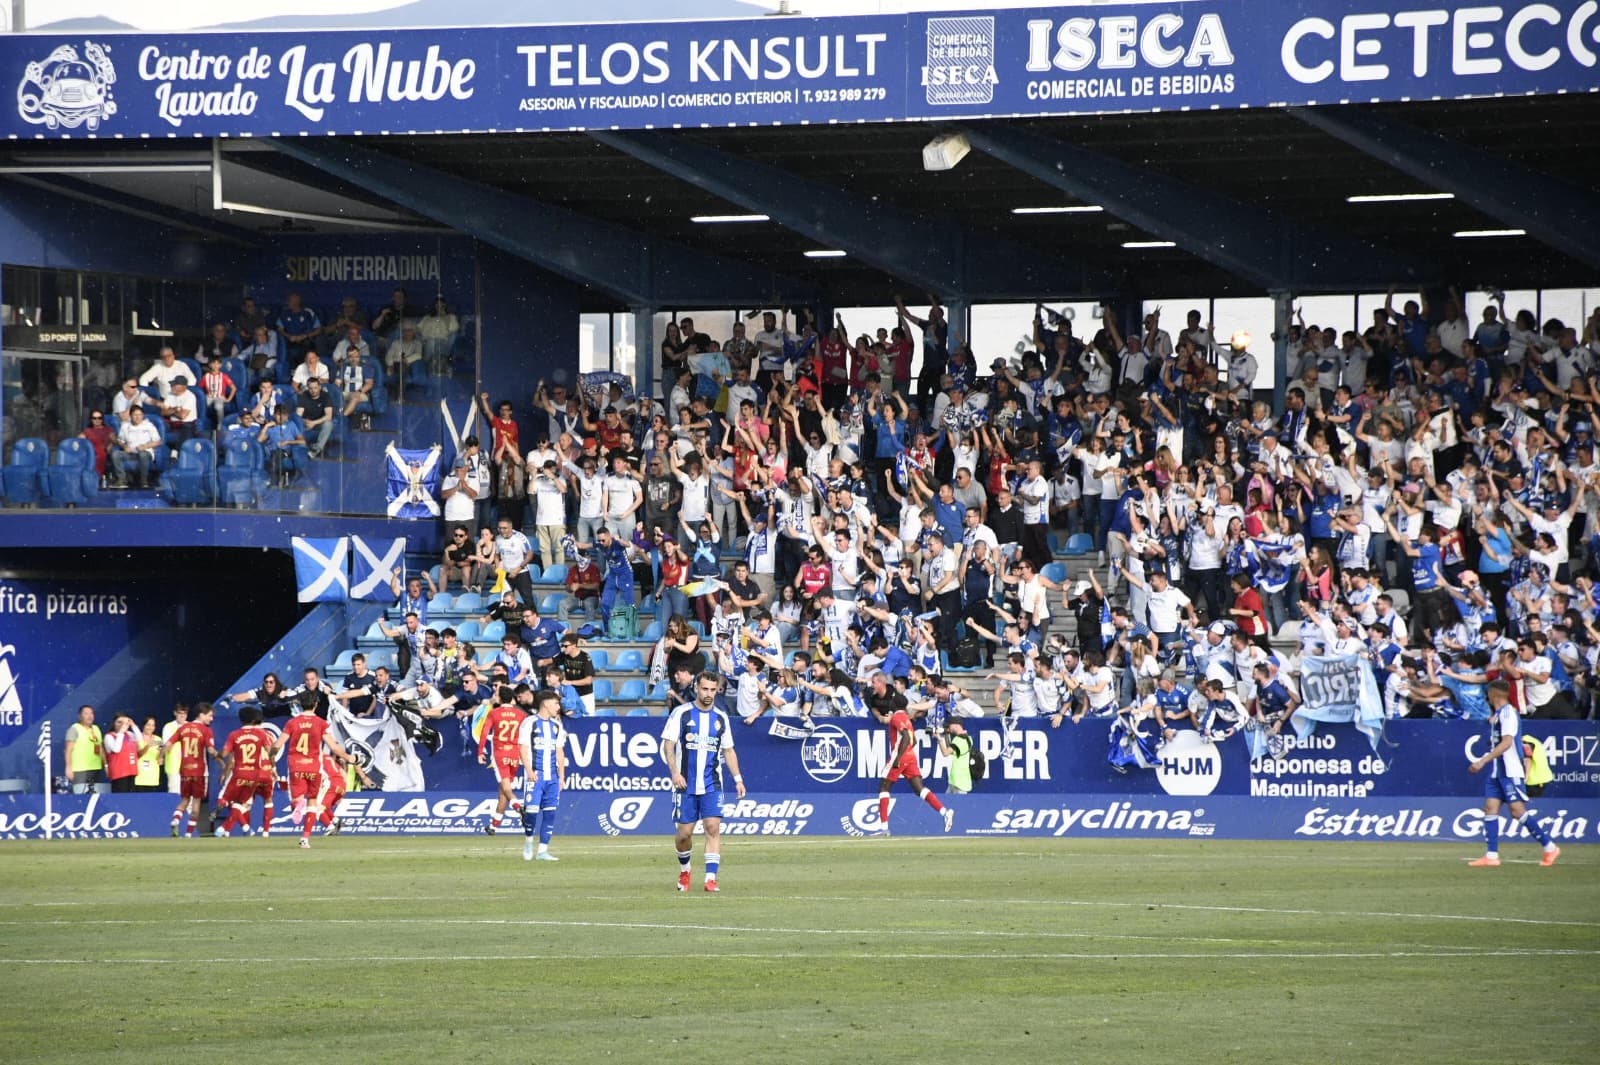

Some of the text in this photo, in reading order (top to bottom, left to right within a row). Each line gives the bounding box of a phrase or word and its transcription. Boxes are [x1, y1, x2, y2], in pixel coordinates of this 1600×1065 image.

[932, 48, 946, 58] DE
[1027, 13, 1234, 73] ISECA
[138, 45, 271, 81] Centro de
[516, 33, 887, 87] TELOS KNSULT
[279, 42, 477, 122] La Nube
[921, 64, 999, 86] ISECA
[1027, 73, 1234, 100] COMERCIAL DE BEBIDAS
[155, 83, 259, 127] Lavado
[519, 86, 886, 111] ASESORIA Y FISCALIDAD COMERCIO EXTERIOR T. 932 989 279
[47, 588, 128, 620] pizarras
[498, 720, 519, 742] 27
[183, 737, 200, 759] 14
[240, 743, 257, 764] 12
[295, 732, 309, 756] 4
[1163, 757, 1213, 776] HJM
[1250, 756, 1385, 778] Japonesa de
[1550, 771, 1589, 783] undial
[721, 799, 814, 822] sRadio
[1294, 807, 1443, 837] Estrella
[692, 819, 808, 836] Brzo 98.7
